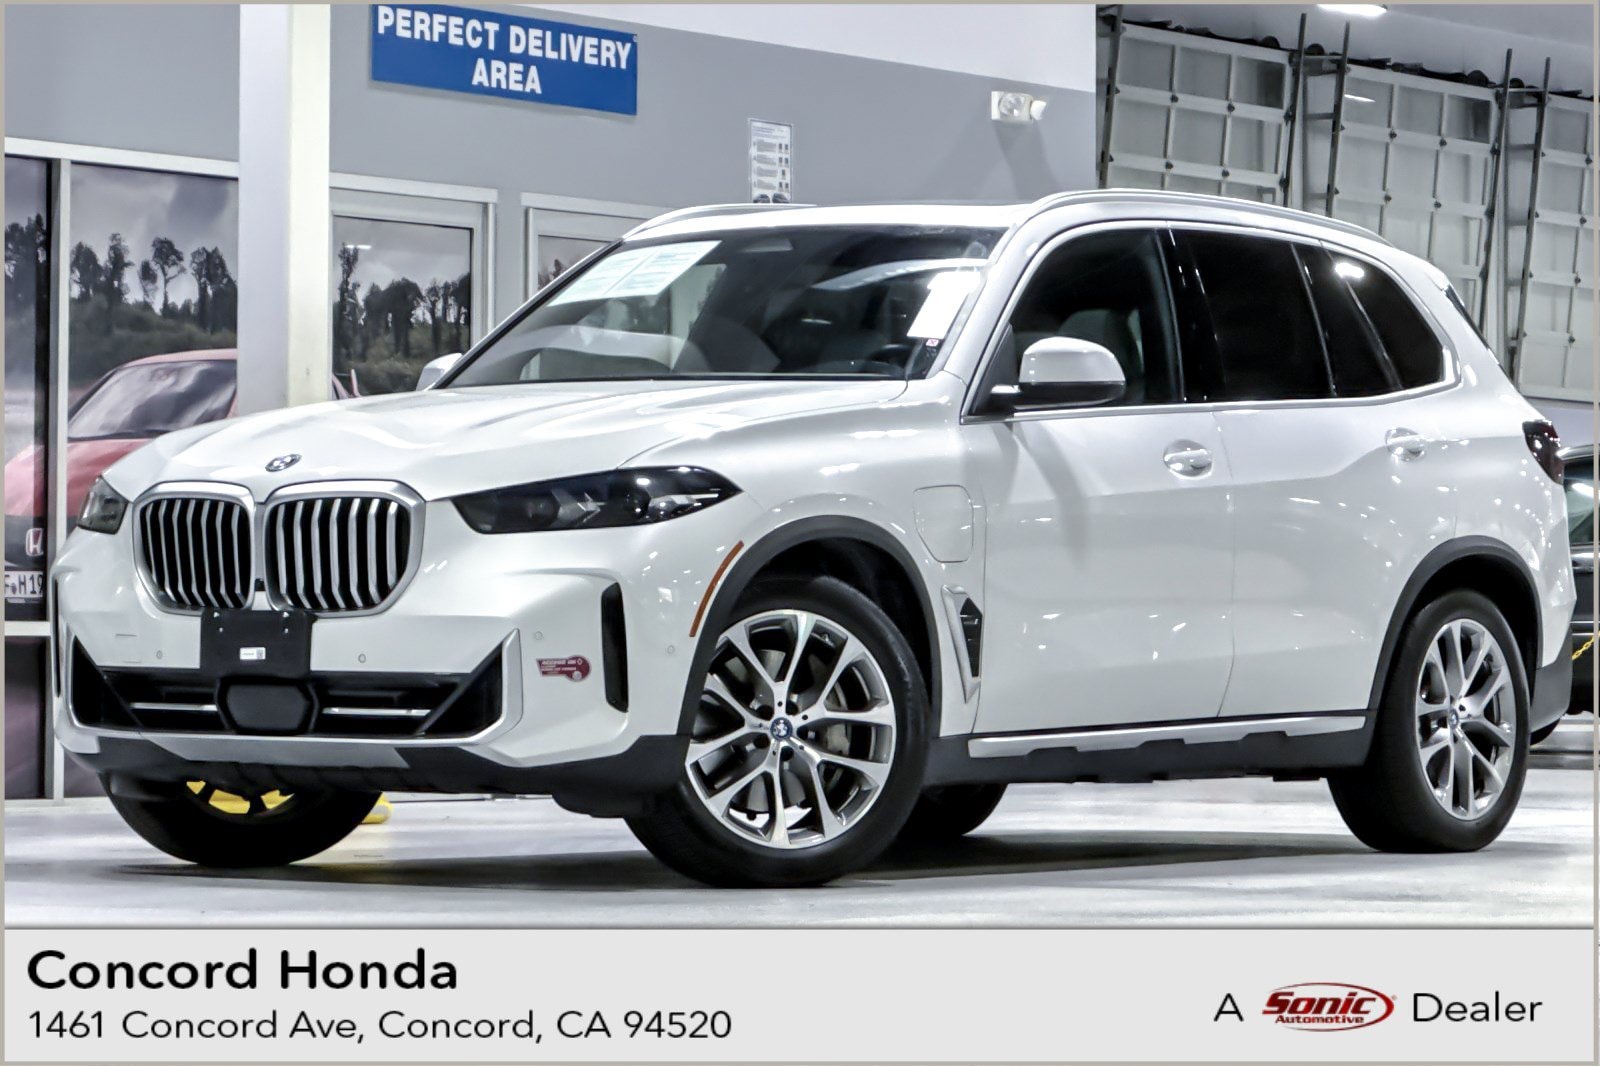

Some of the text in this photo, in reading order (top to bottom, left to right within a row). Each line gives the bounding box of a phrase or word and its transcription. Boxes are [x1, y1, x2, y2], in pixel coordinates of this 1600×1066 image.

[377, 6, 632, 70] PERFECT DELIVERY
[471, 58, 542, 94] AREA
